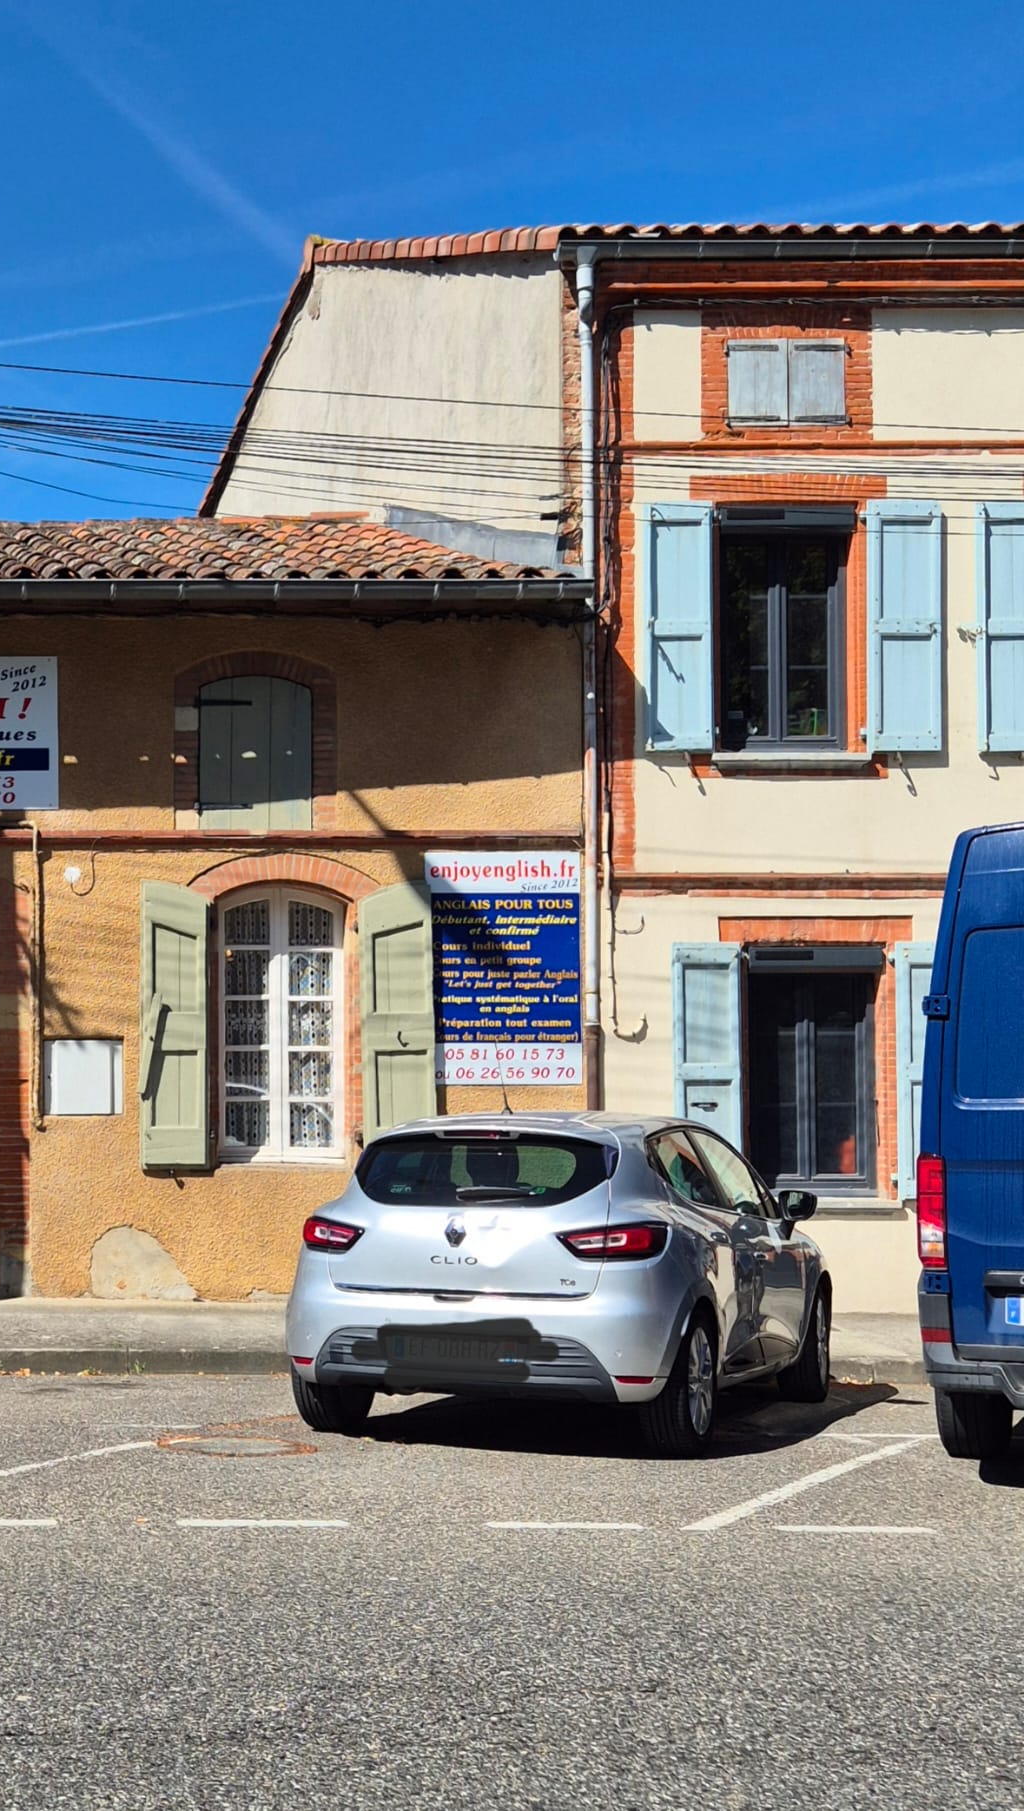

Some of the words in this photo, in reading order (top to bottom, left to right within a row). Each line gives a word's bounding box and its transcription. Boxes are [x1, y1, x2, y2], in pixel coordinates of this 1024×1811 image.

[0, 664, 36, 681] Since
[11, 676, 47, 692] 2012
[430, 859, 575, 882] enjoyenglish.fr
[520, 883, 548, 893] Since
[551, 878, 578, 889] 2012
[434, 899, 491, 910] ANGLAIS
[495, 899, 533, 910] POUR
[537, 899, 573, 910] TOUS
[469, 927, 481, 935] et
[486, 925, 540, 935] confirmé
[434, 941, 468, 951] Cours
[472, 940, 531, 951] individuel
[464, 957, 477, 965] en
[480, 955, 503, 966] petit
[507, 957, 542, 966] groupe
[463, 971, 485, 980] pour
[487, 969, 510, 980] juste
[513, 969, 541, 980] parler
[544, 969, 578, 980] Anglais
[474, 980, 493, 990] just
[496, 981, 512, 990] get
[476, 994, 540, 1005] systématique
[543, 994, 550, 1003] à
[495, 1004, 530, 1015] anglais
[439, 1018, 502, 1029] Préparation
[506, 1018, 527, 1027] tout
[531, 1019, 572, 1028] examen
[462, 1031, 474, 1041] de
[514, 1034, 536, 1043] pour
[445, 1048, 465, 1060] 05
[470, 1048, 488, 1060] 81
[495, 1048, 515, 1060] 60
[522, 1048, 540, 1060] 15
[546, 1048, 565, 1060] 73
[435, 1071, 450, 1079] ou
[455, 1067, 475, 1079] 06
[480, 1067, 500, 1079] 26
[506, 1067, 525, 1079] 56
[531, 1067, 550, 1079] 90
[556, 1067, 575, 1079] 70
[430, 1255, 478, 1265] CLIO
